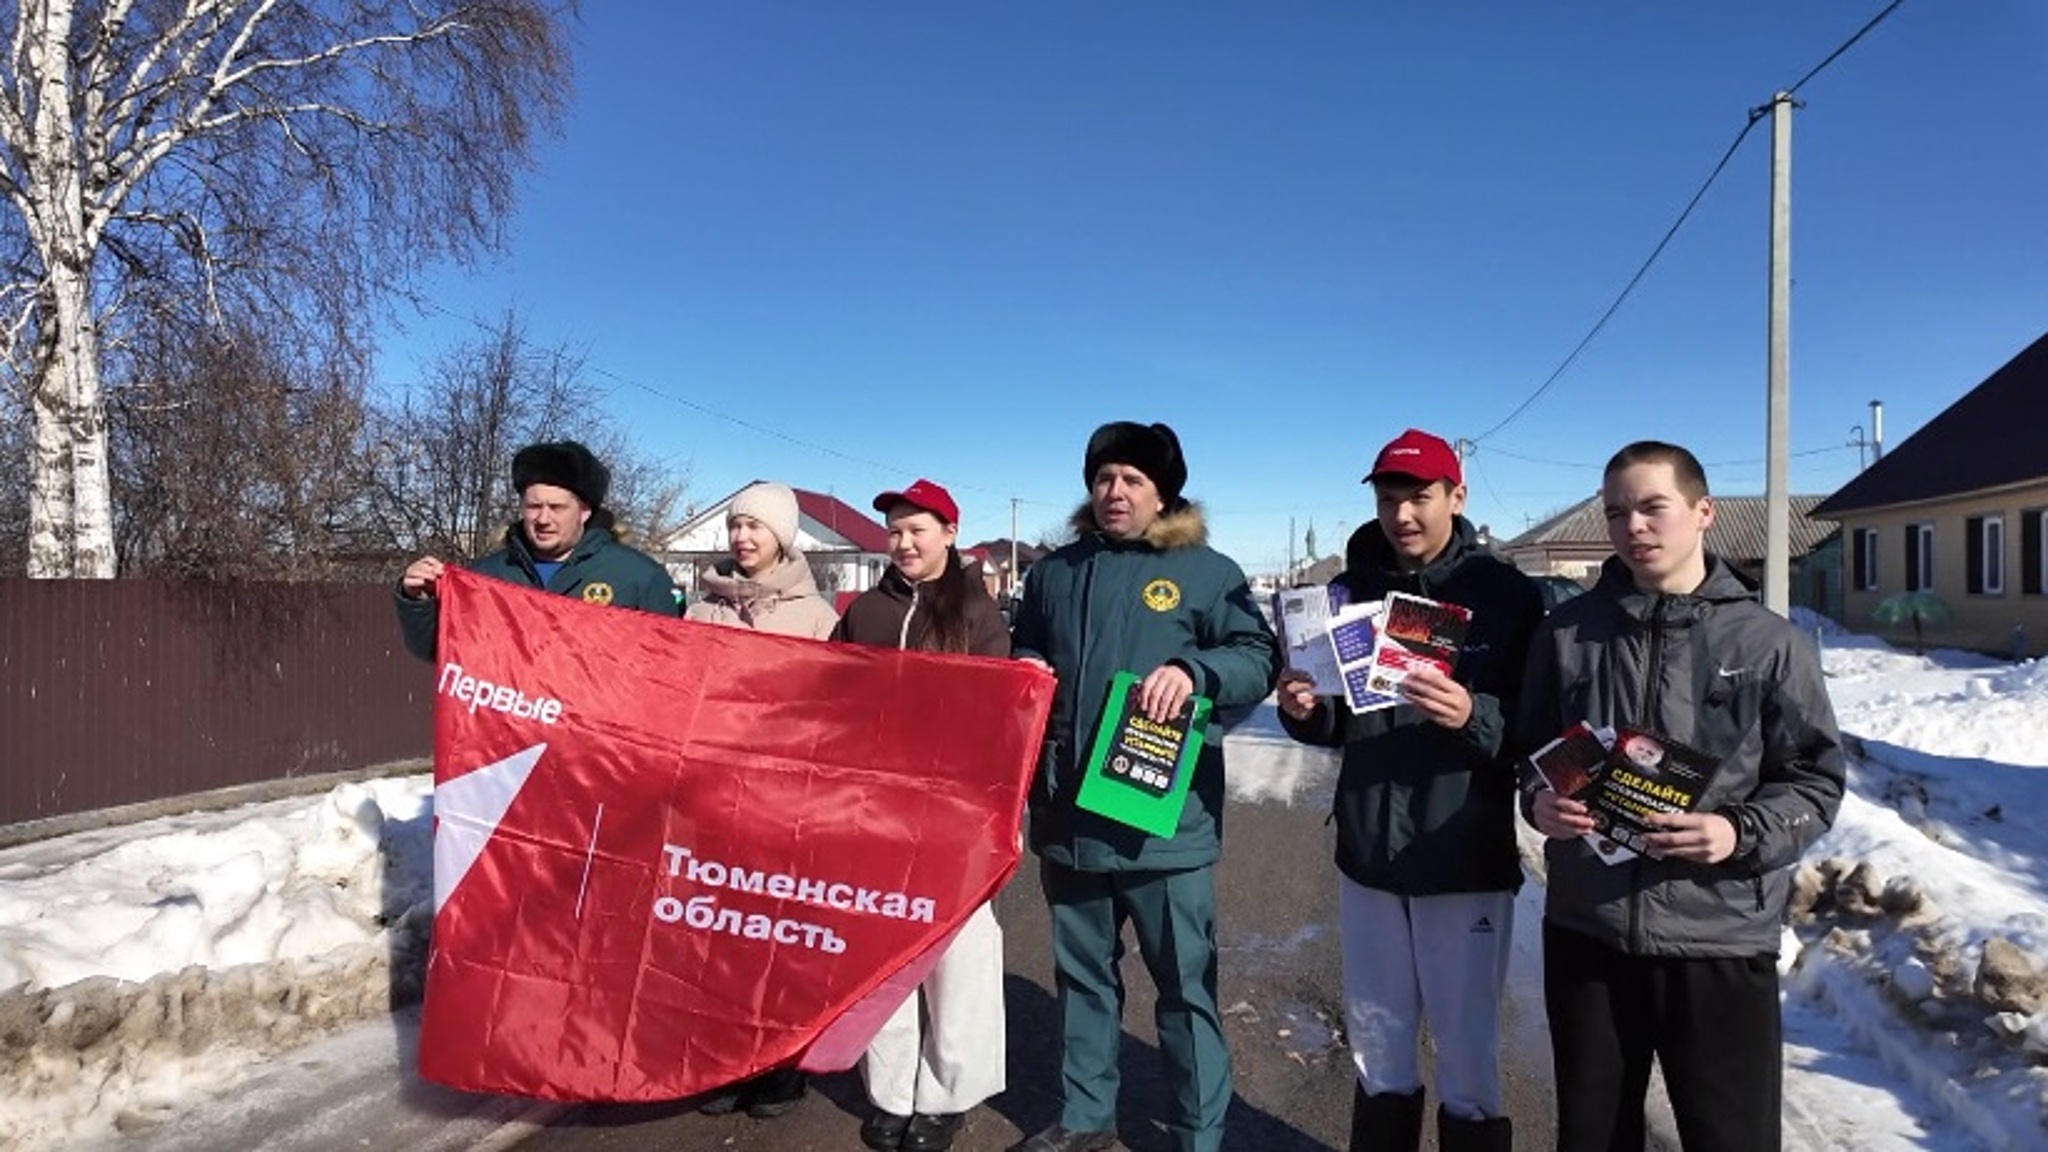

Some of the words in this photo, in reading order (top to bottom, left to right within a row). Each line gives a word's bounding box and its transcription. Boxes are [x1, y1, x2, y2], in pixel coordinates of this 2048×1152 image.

[437, 662, 563, 725] Первые
[1610, 767, 1692, 807] СДЕЛАЙТЕ
[663, 843, 936, 923] Тюменская
[653, 896, 847, 954] область
